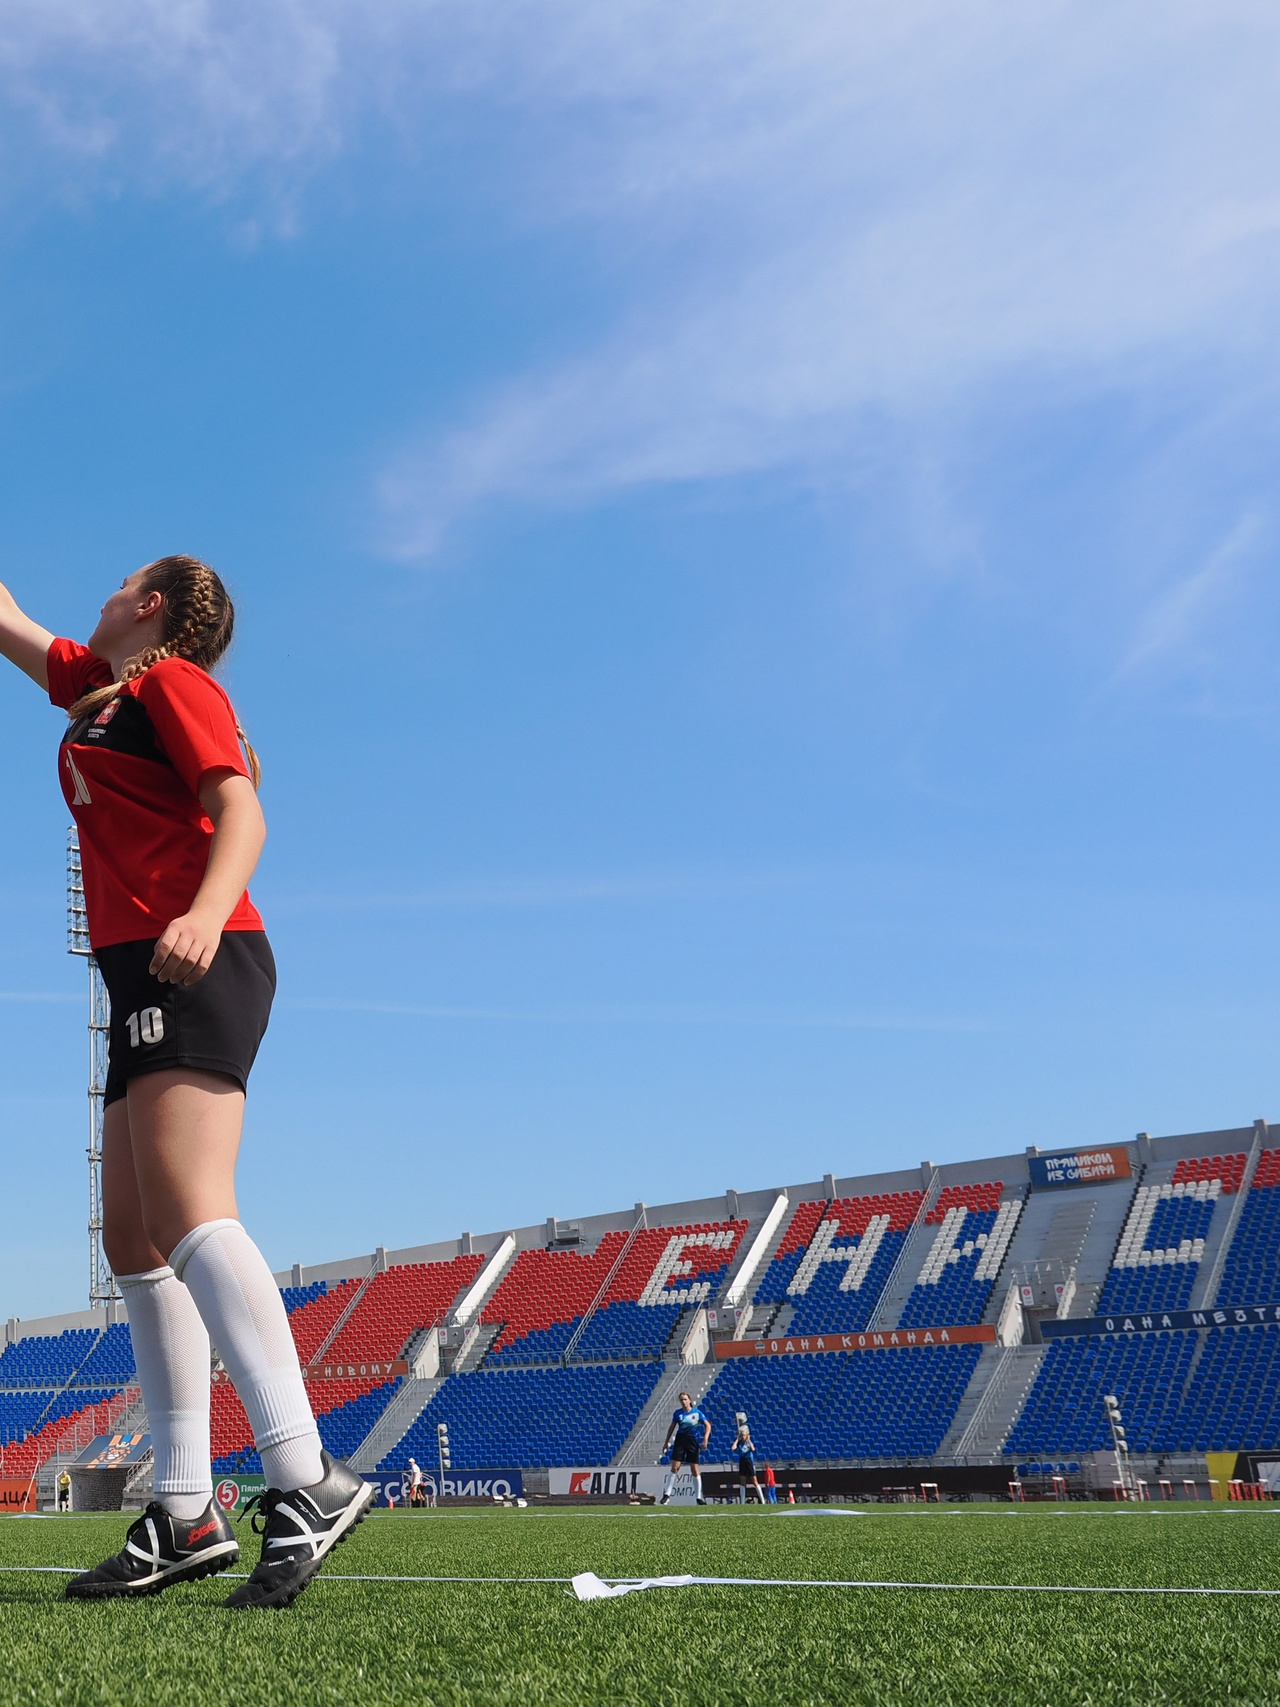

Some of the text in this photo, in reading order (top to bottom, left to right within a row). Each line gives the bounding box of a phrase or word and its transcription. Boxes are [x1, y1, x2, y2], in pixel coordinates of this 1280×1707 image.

[125, 1006, 164, 1048] 10
[1045, 1153, 1113, 1170] ПРЯМИКОМ
[1047, 1170, 1065, 1182] ИЗ
[1105, 1315, 1172, 1331] ОДНА
[771, 1330, 950, 1352] ОДНА КОМАНДА
[590, 1472, 640, 1495] АГАТ
